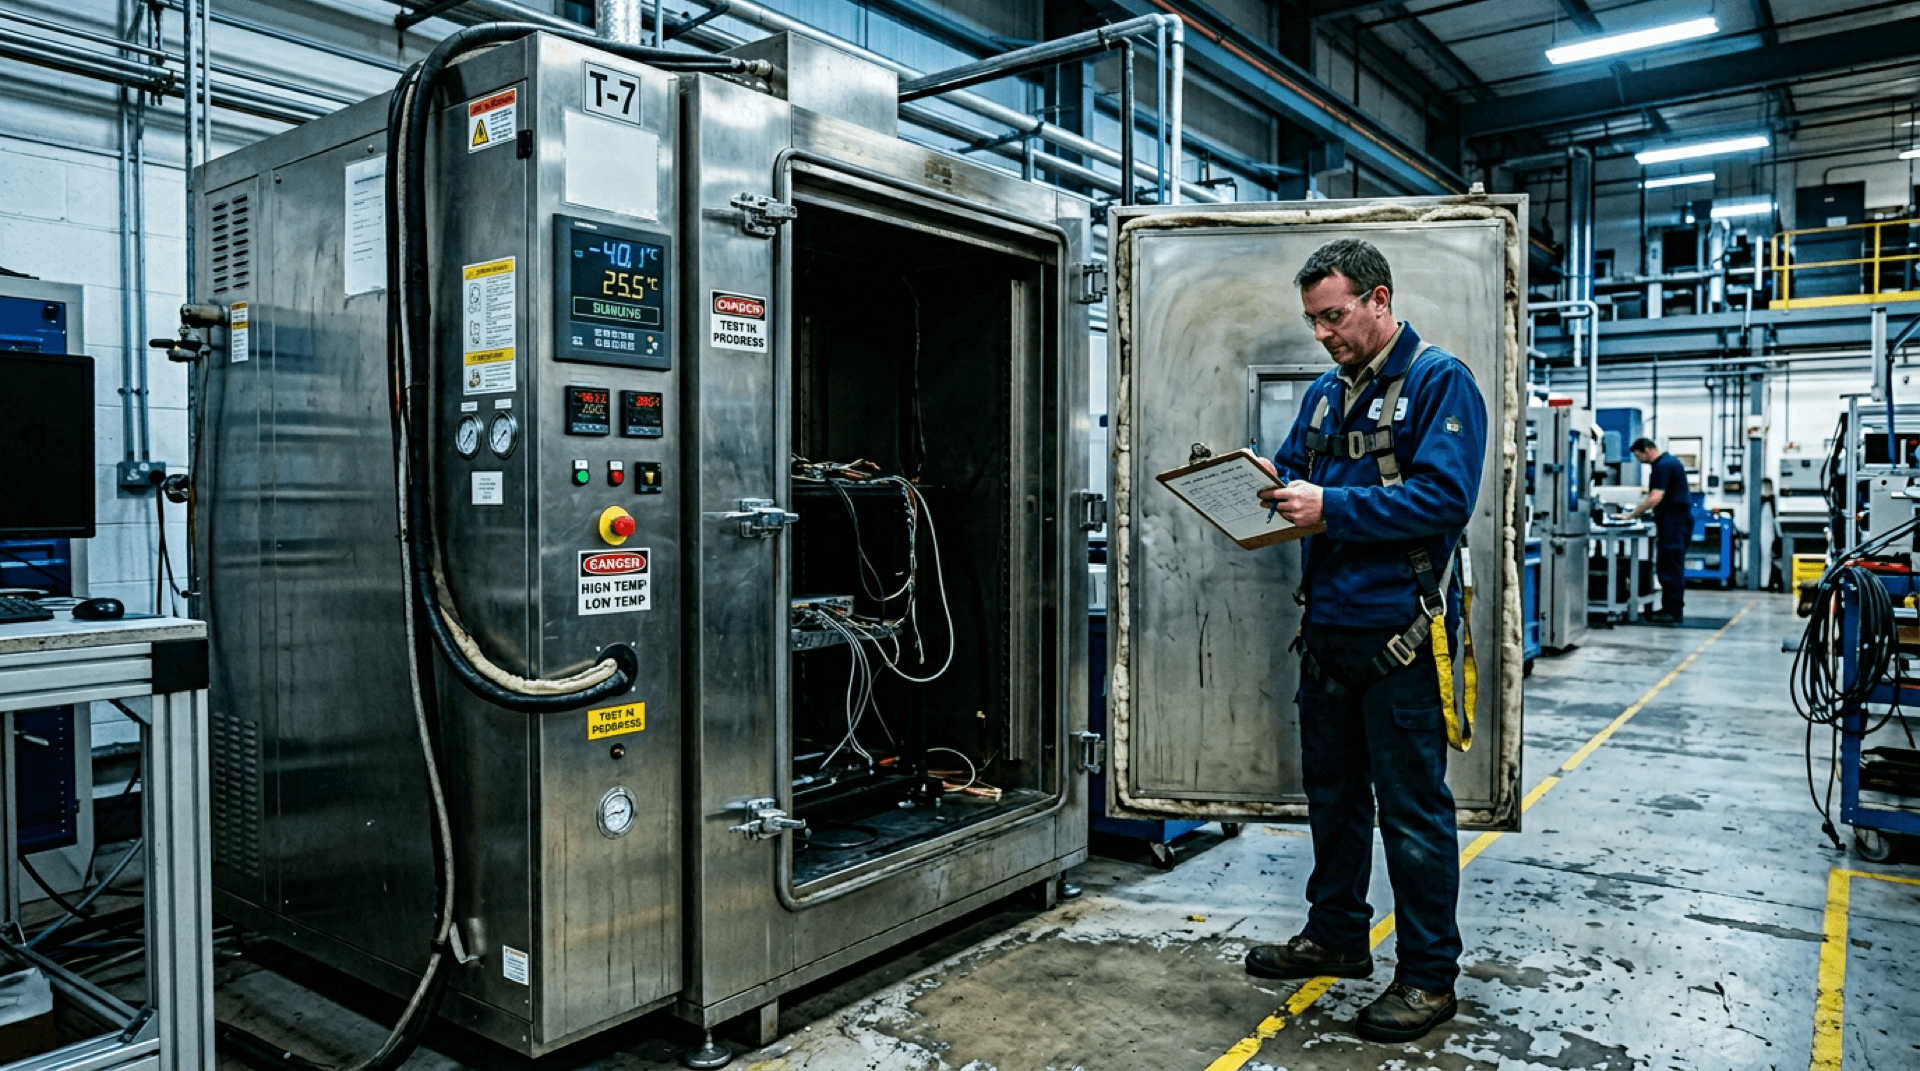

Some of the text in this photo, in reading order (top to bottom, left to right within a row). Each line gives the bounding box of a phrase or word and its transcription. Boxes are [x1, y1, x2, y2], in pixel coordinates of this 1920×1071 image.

[589, 70, 636, 115] T-7
[720, 320, 744, 332] TEST
[614, 579, 647, 592] TEMP
